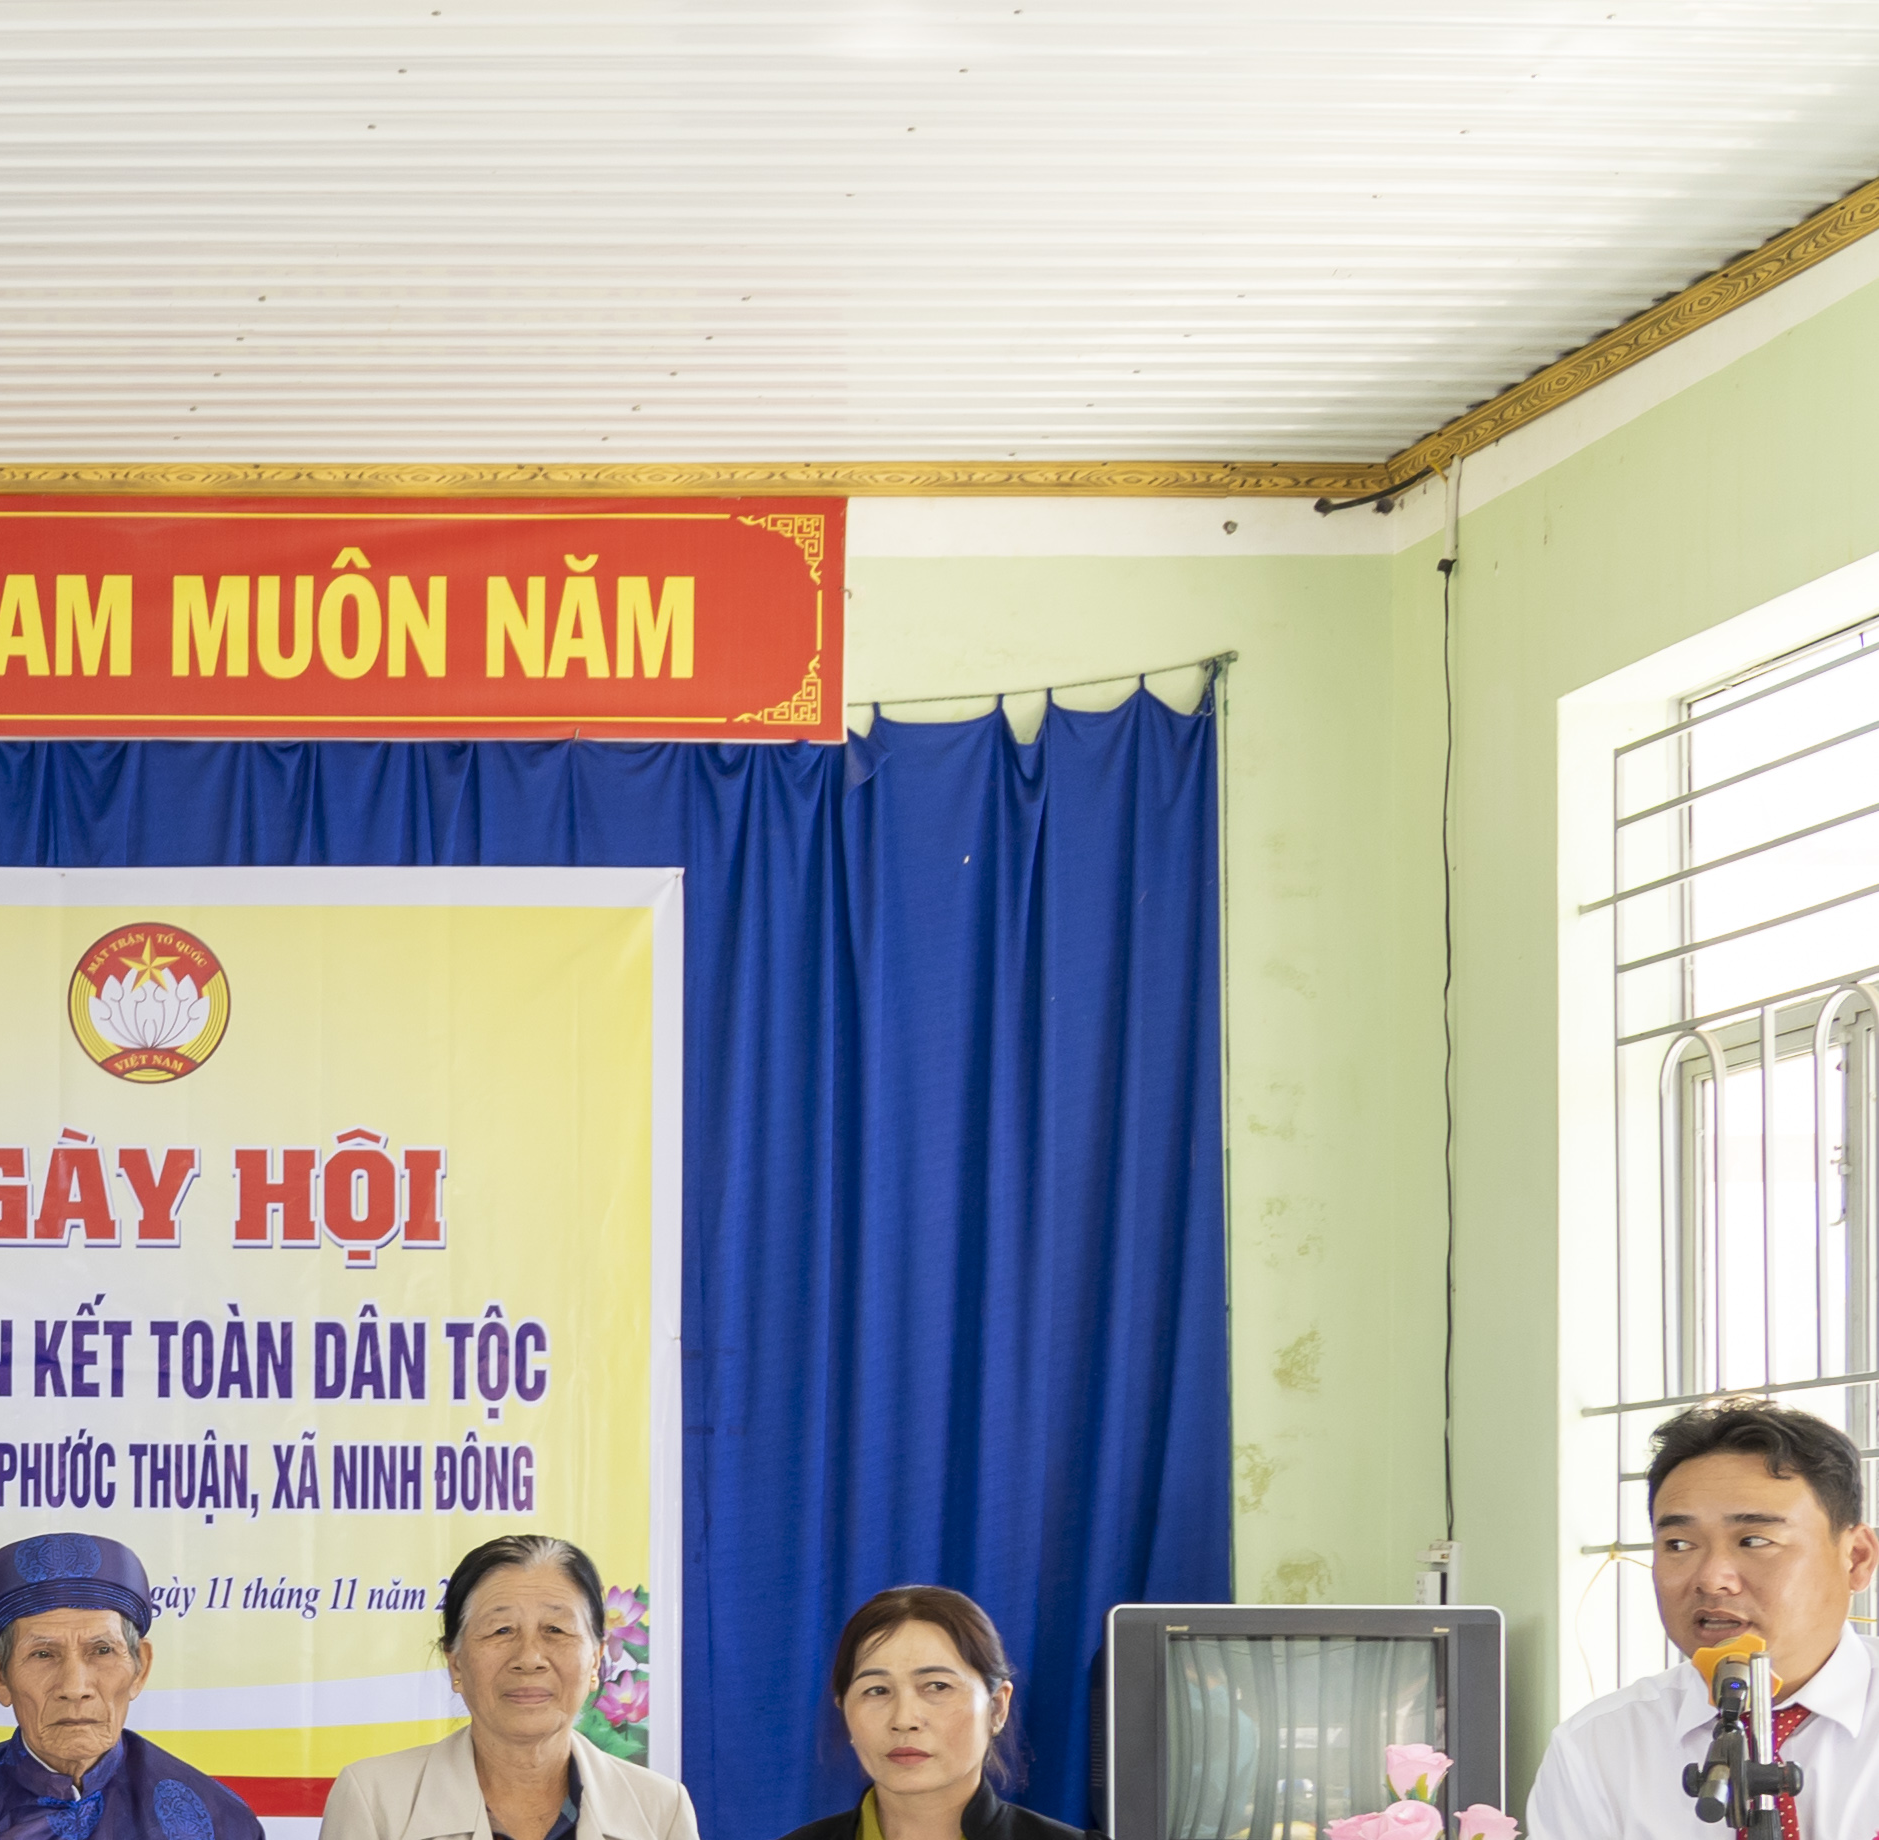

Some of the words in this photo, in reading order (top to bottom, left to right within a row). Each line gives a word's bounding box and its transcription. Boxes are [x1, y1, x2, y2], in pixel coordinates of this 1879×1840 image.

[172, 548, 447, 679] MUÔN
[486, 554, 694, 678] NĂM
[114, 1054, 146, 1072] VIỆT
[152, 1054, 183, 1072] NAM
[235, 1127, 446, 1266] HỘI
[35, 1294, 131, 1397] KẾT
[150, 1304, 292, 1399] TOÀN
[315, 1305, 425, 1399] DÂN
[446, 1306, 545, 1418] TỘC
[129, 1430, 258, 1523] THUẬN,
[272, 1432, 319, 1508] XÃ
[334, 1446, 421, 1509] NINH
[435, 1432, 532, 1511] ĐÔNG
[150, 1583, 196, 1619] gày
[206, 1577, 232, 1610] 11
[243, 1577, 320, 1619] tháng
[330, 1578, 357, 1611] 11
[367, 1582, 426, 1611] năm
